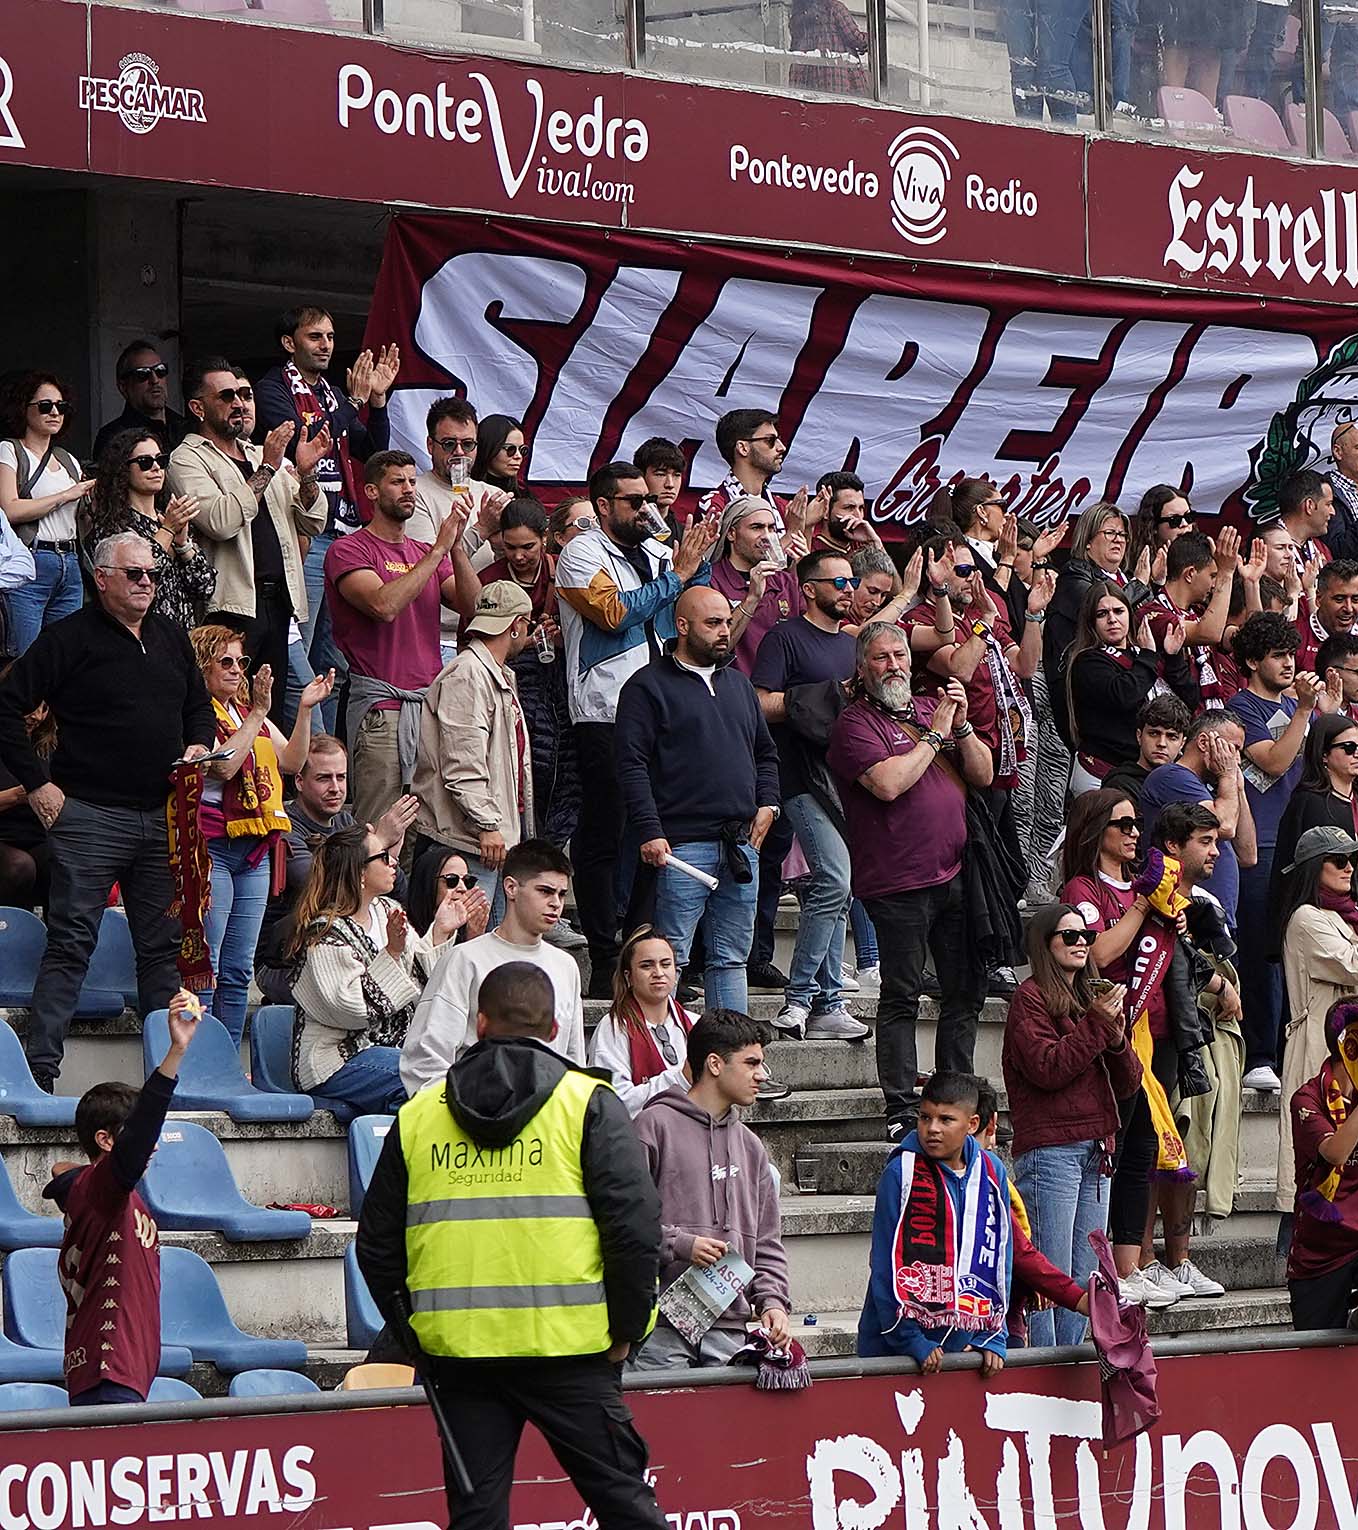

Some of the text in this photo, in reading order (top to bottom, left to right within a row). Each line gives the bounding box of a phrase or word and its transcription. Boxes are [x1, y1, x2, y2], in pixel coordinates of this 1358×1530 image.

[79, 76, 207, 122] PESCAMAR
[729, 144, 880, 199] Pontevedra
[895, 166, 946, 207] Viva
[965, 173, 1039, 218] Radio
[448, 1167, 523, 1187] Seguridad
[0, 1445, 317, 1530] CONSERVAS
